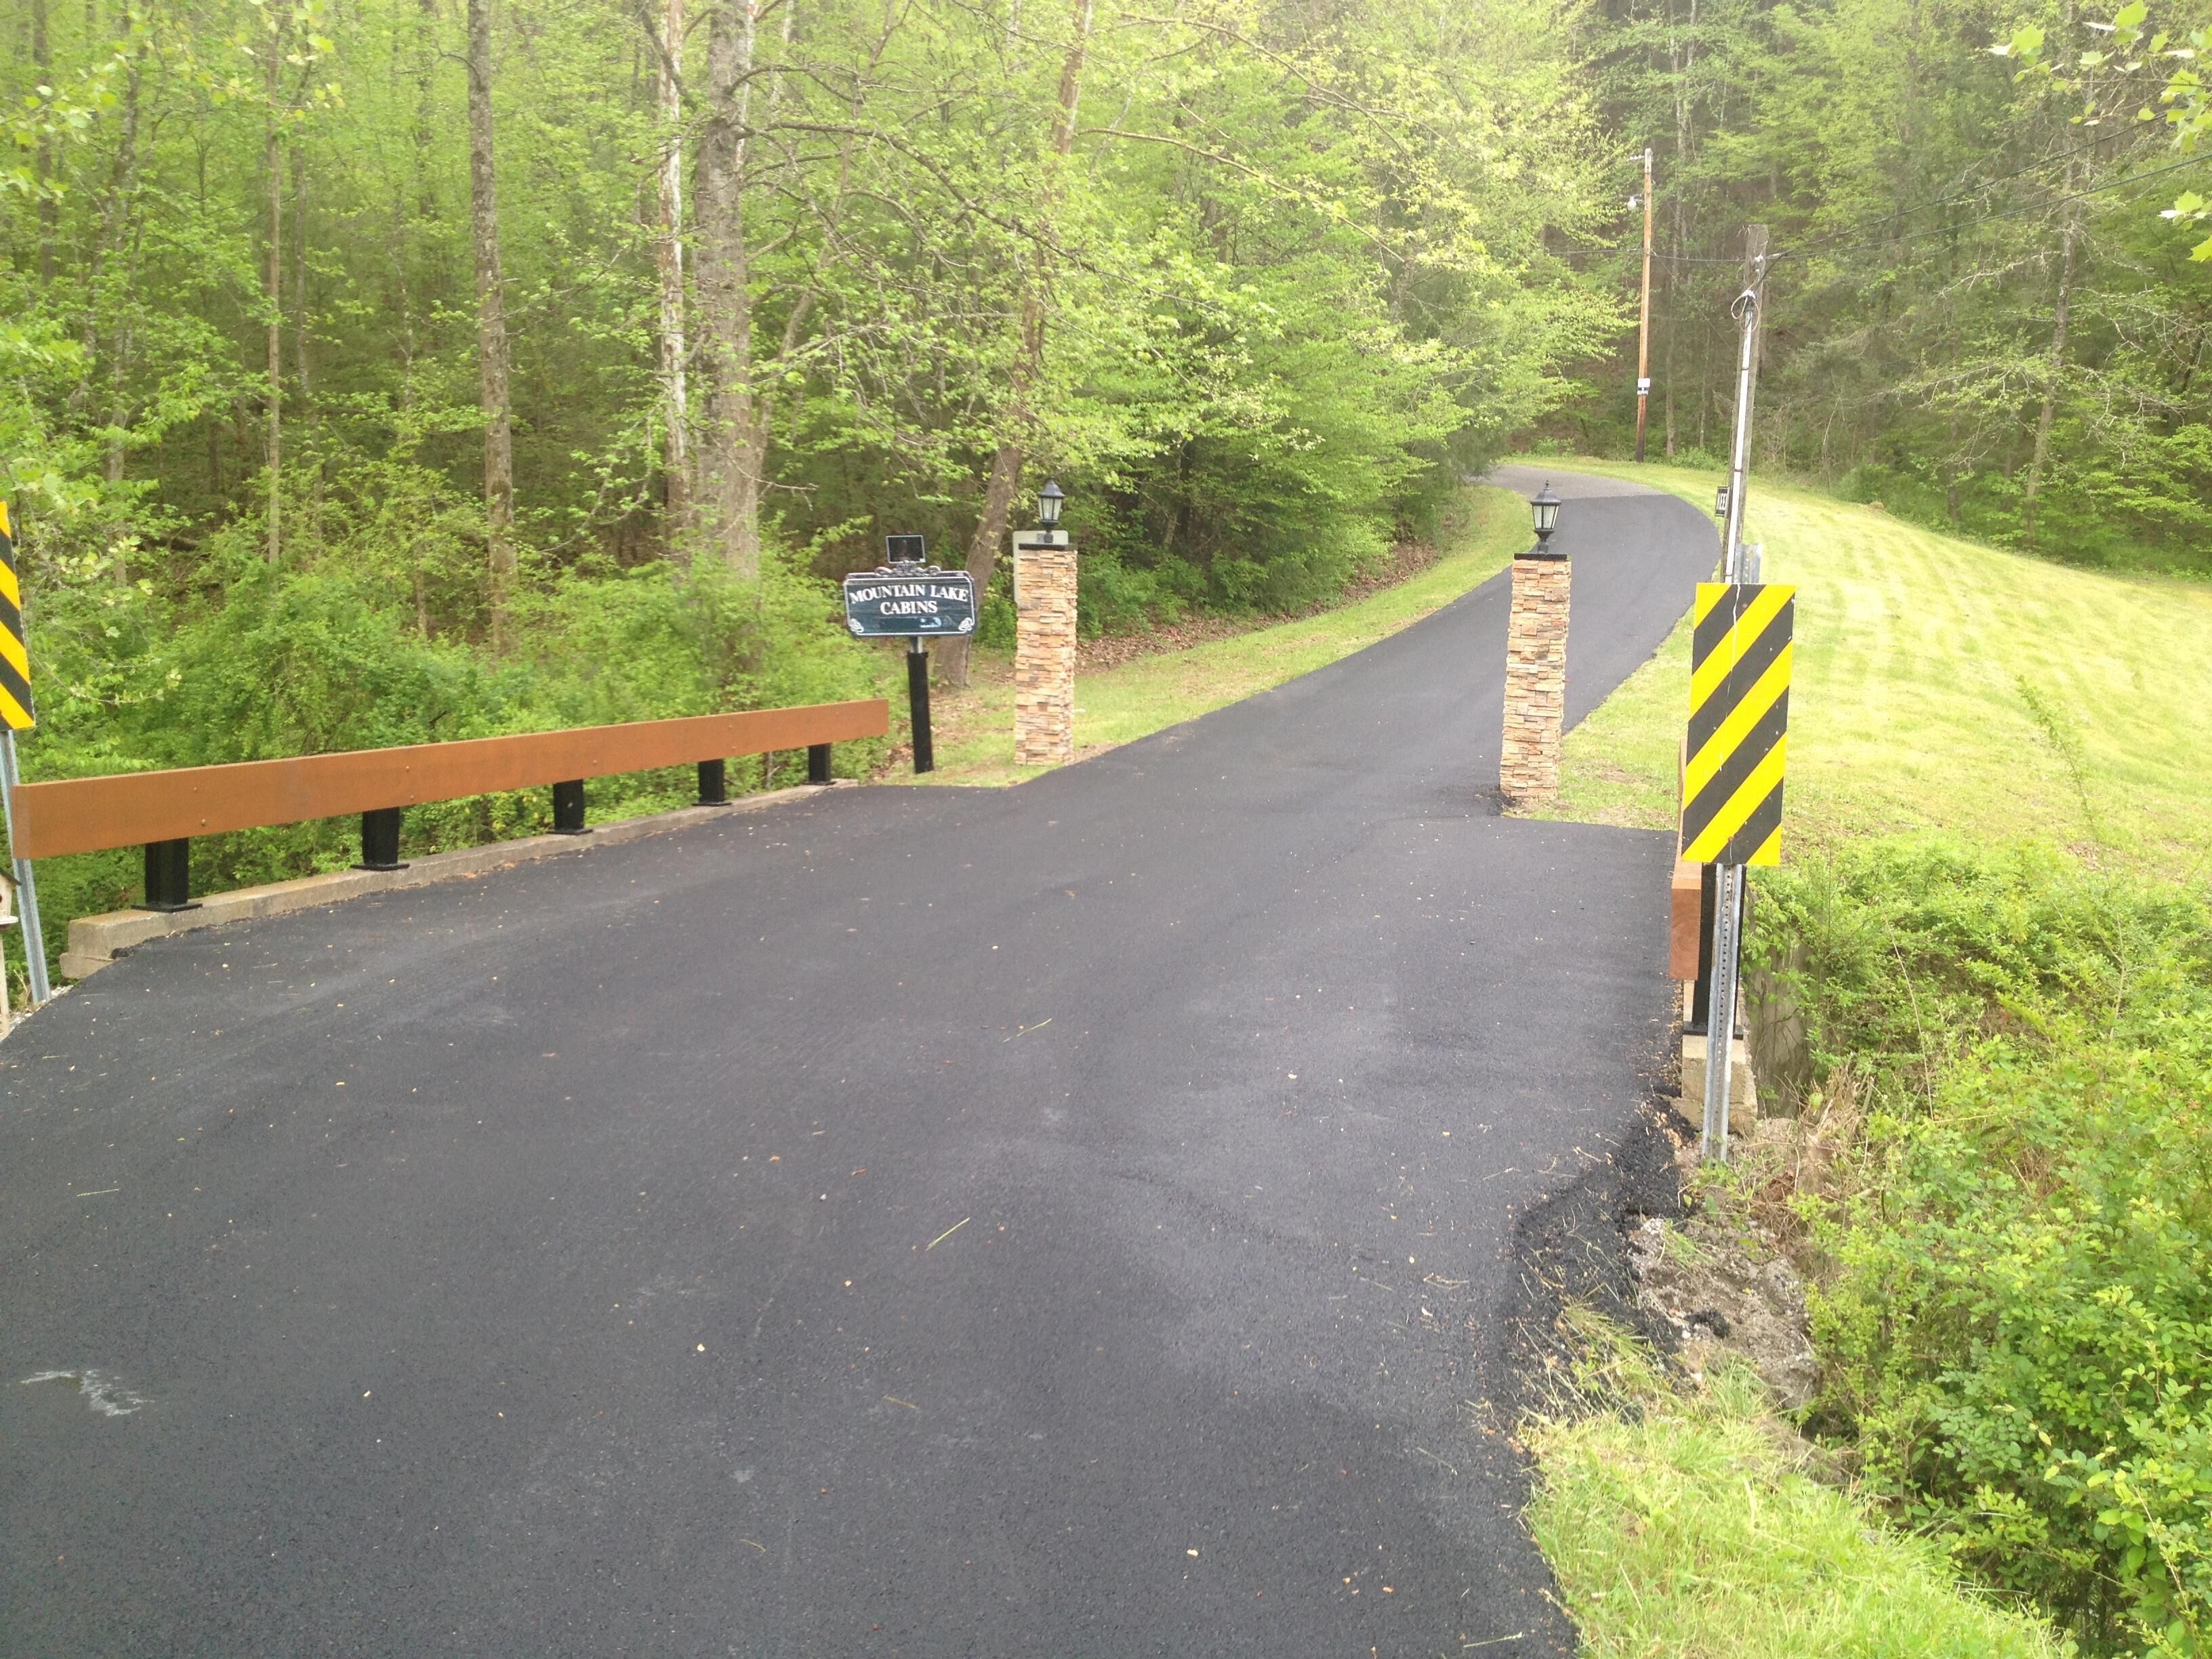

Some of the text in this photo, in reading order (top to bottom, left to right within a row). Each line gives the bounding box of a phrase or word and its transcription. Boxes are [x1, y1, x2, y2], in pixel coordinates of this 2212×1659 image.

[848, 584, 969, 604] MOUNTAIN LAKE
[880, 600, 938, 615] CABINS
